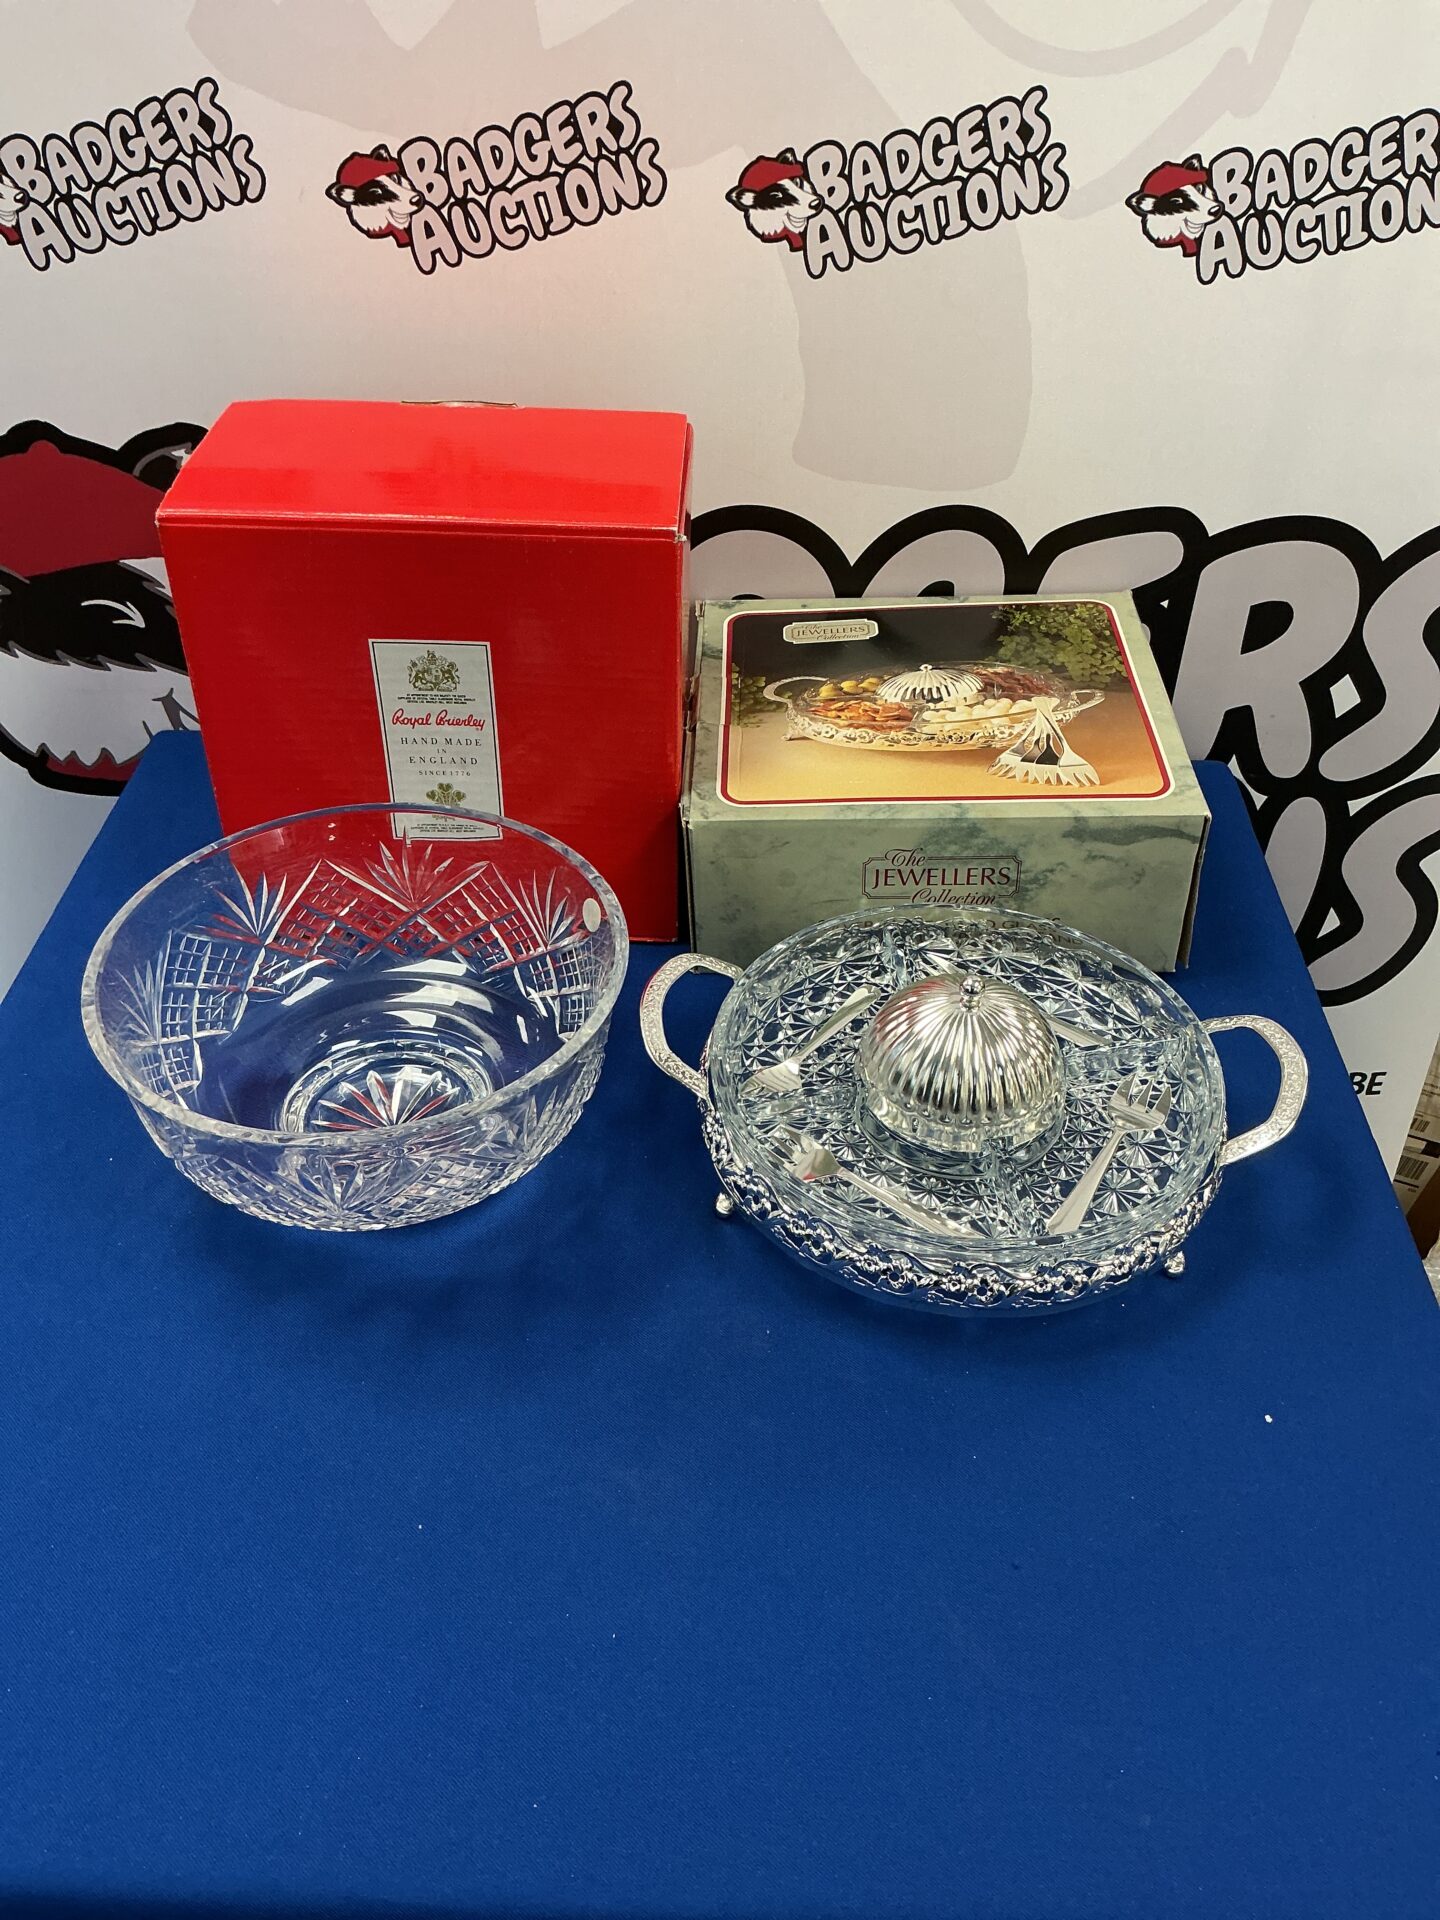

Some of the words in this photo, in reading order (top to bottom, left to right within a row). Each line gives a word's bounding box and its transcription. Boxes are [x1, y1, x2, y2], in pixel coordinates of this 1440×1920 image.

[0, 76, 233, 206] BADGERS
[399, 80, 640, 206] BADGERS
[804, 85, 1051, 212] BADGERS
[1208, 108, 1440, 220] BADGER
[18, 133, 267, 272] AUCTIONS
[411, 138, 667, 275] AUCTIONS
[804, 143, 1069, 279] AUCTIONS
[1196, 168, 1440, 285] AUCTION
[796, 626, 866, 637] JEWELLERS
[391, 707, 432, 730] Royal
[435, 709, 486, 731] Brierley
[400, 737, 439, 745] HAND
[444, 738, 482, 747] MADE
[409, 756, 479, 766] ENGLAND
[871, 866, 1011, 890] JEWELLERS
[884, 848, 926, 867] The
[911, 887, 996, 905] Collection
